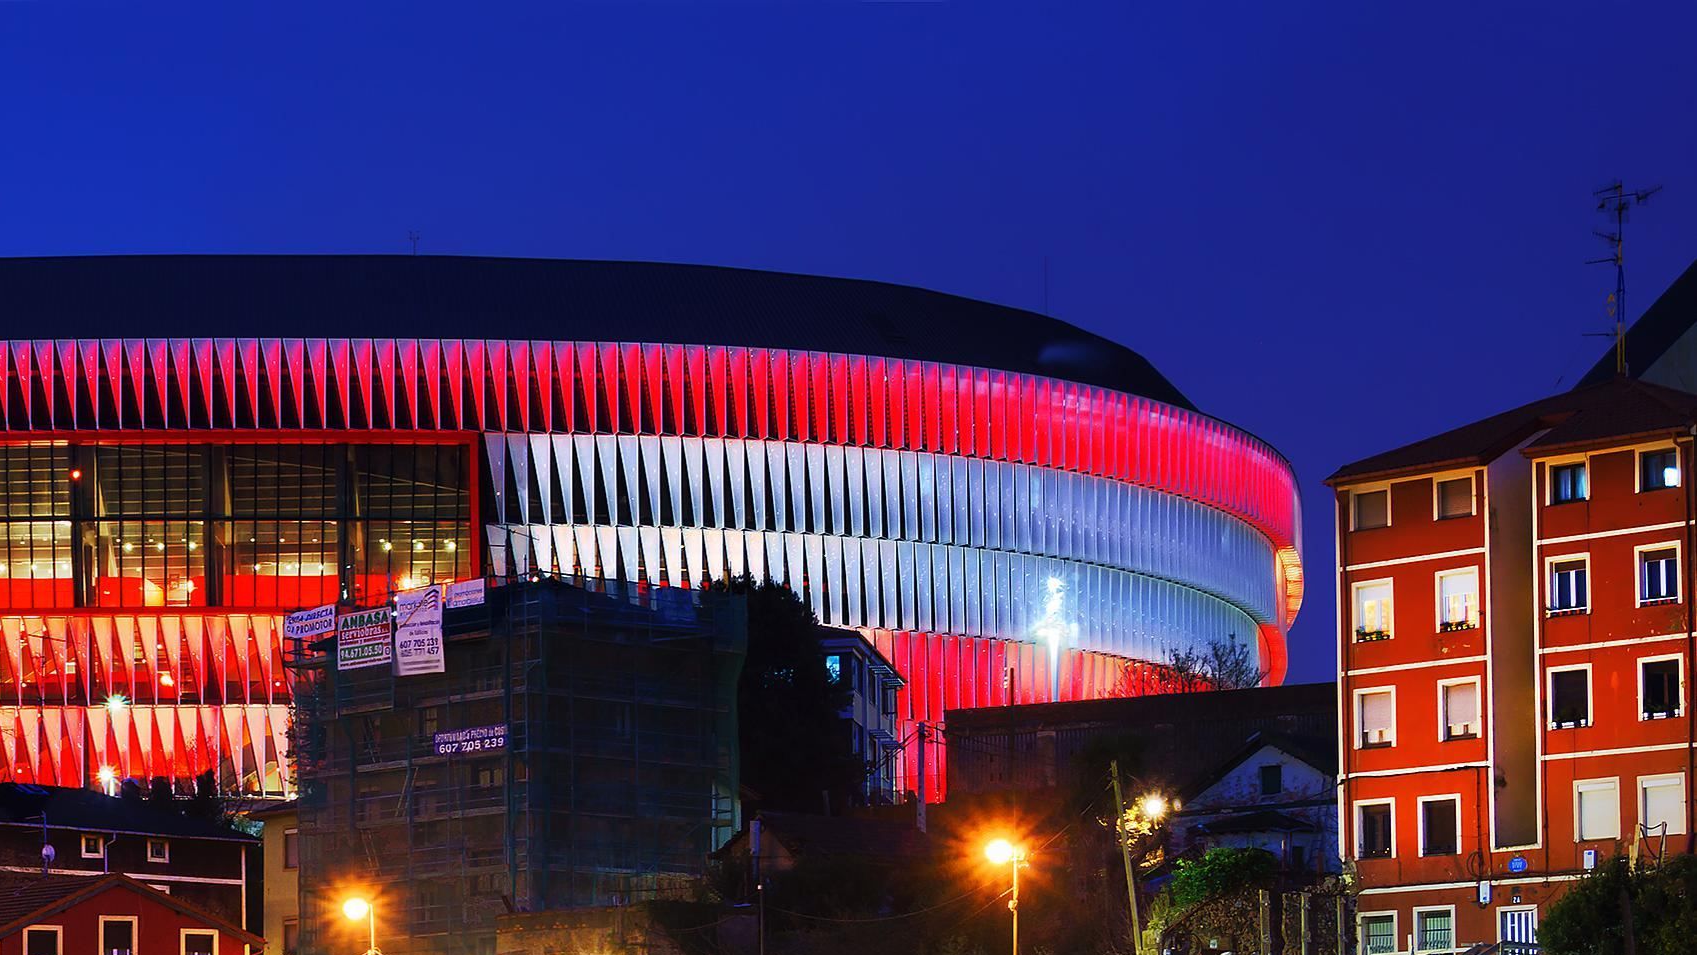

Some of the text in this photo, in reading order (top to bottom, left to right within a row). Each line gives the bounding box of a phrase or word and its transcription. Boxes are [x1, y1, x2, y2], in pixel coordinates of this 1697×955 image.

[295, 618, 333, 634] PROMOTOR
[342, 611, 389, 629] ANBASA
[399, 639, 412, 649] 607
[413, 638, 426, 648] 705
[427, 637, 439, 647] 239
[427, 646, 440, 656] 457
[439, 737, 504, 754] 607 705 239
